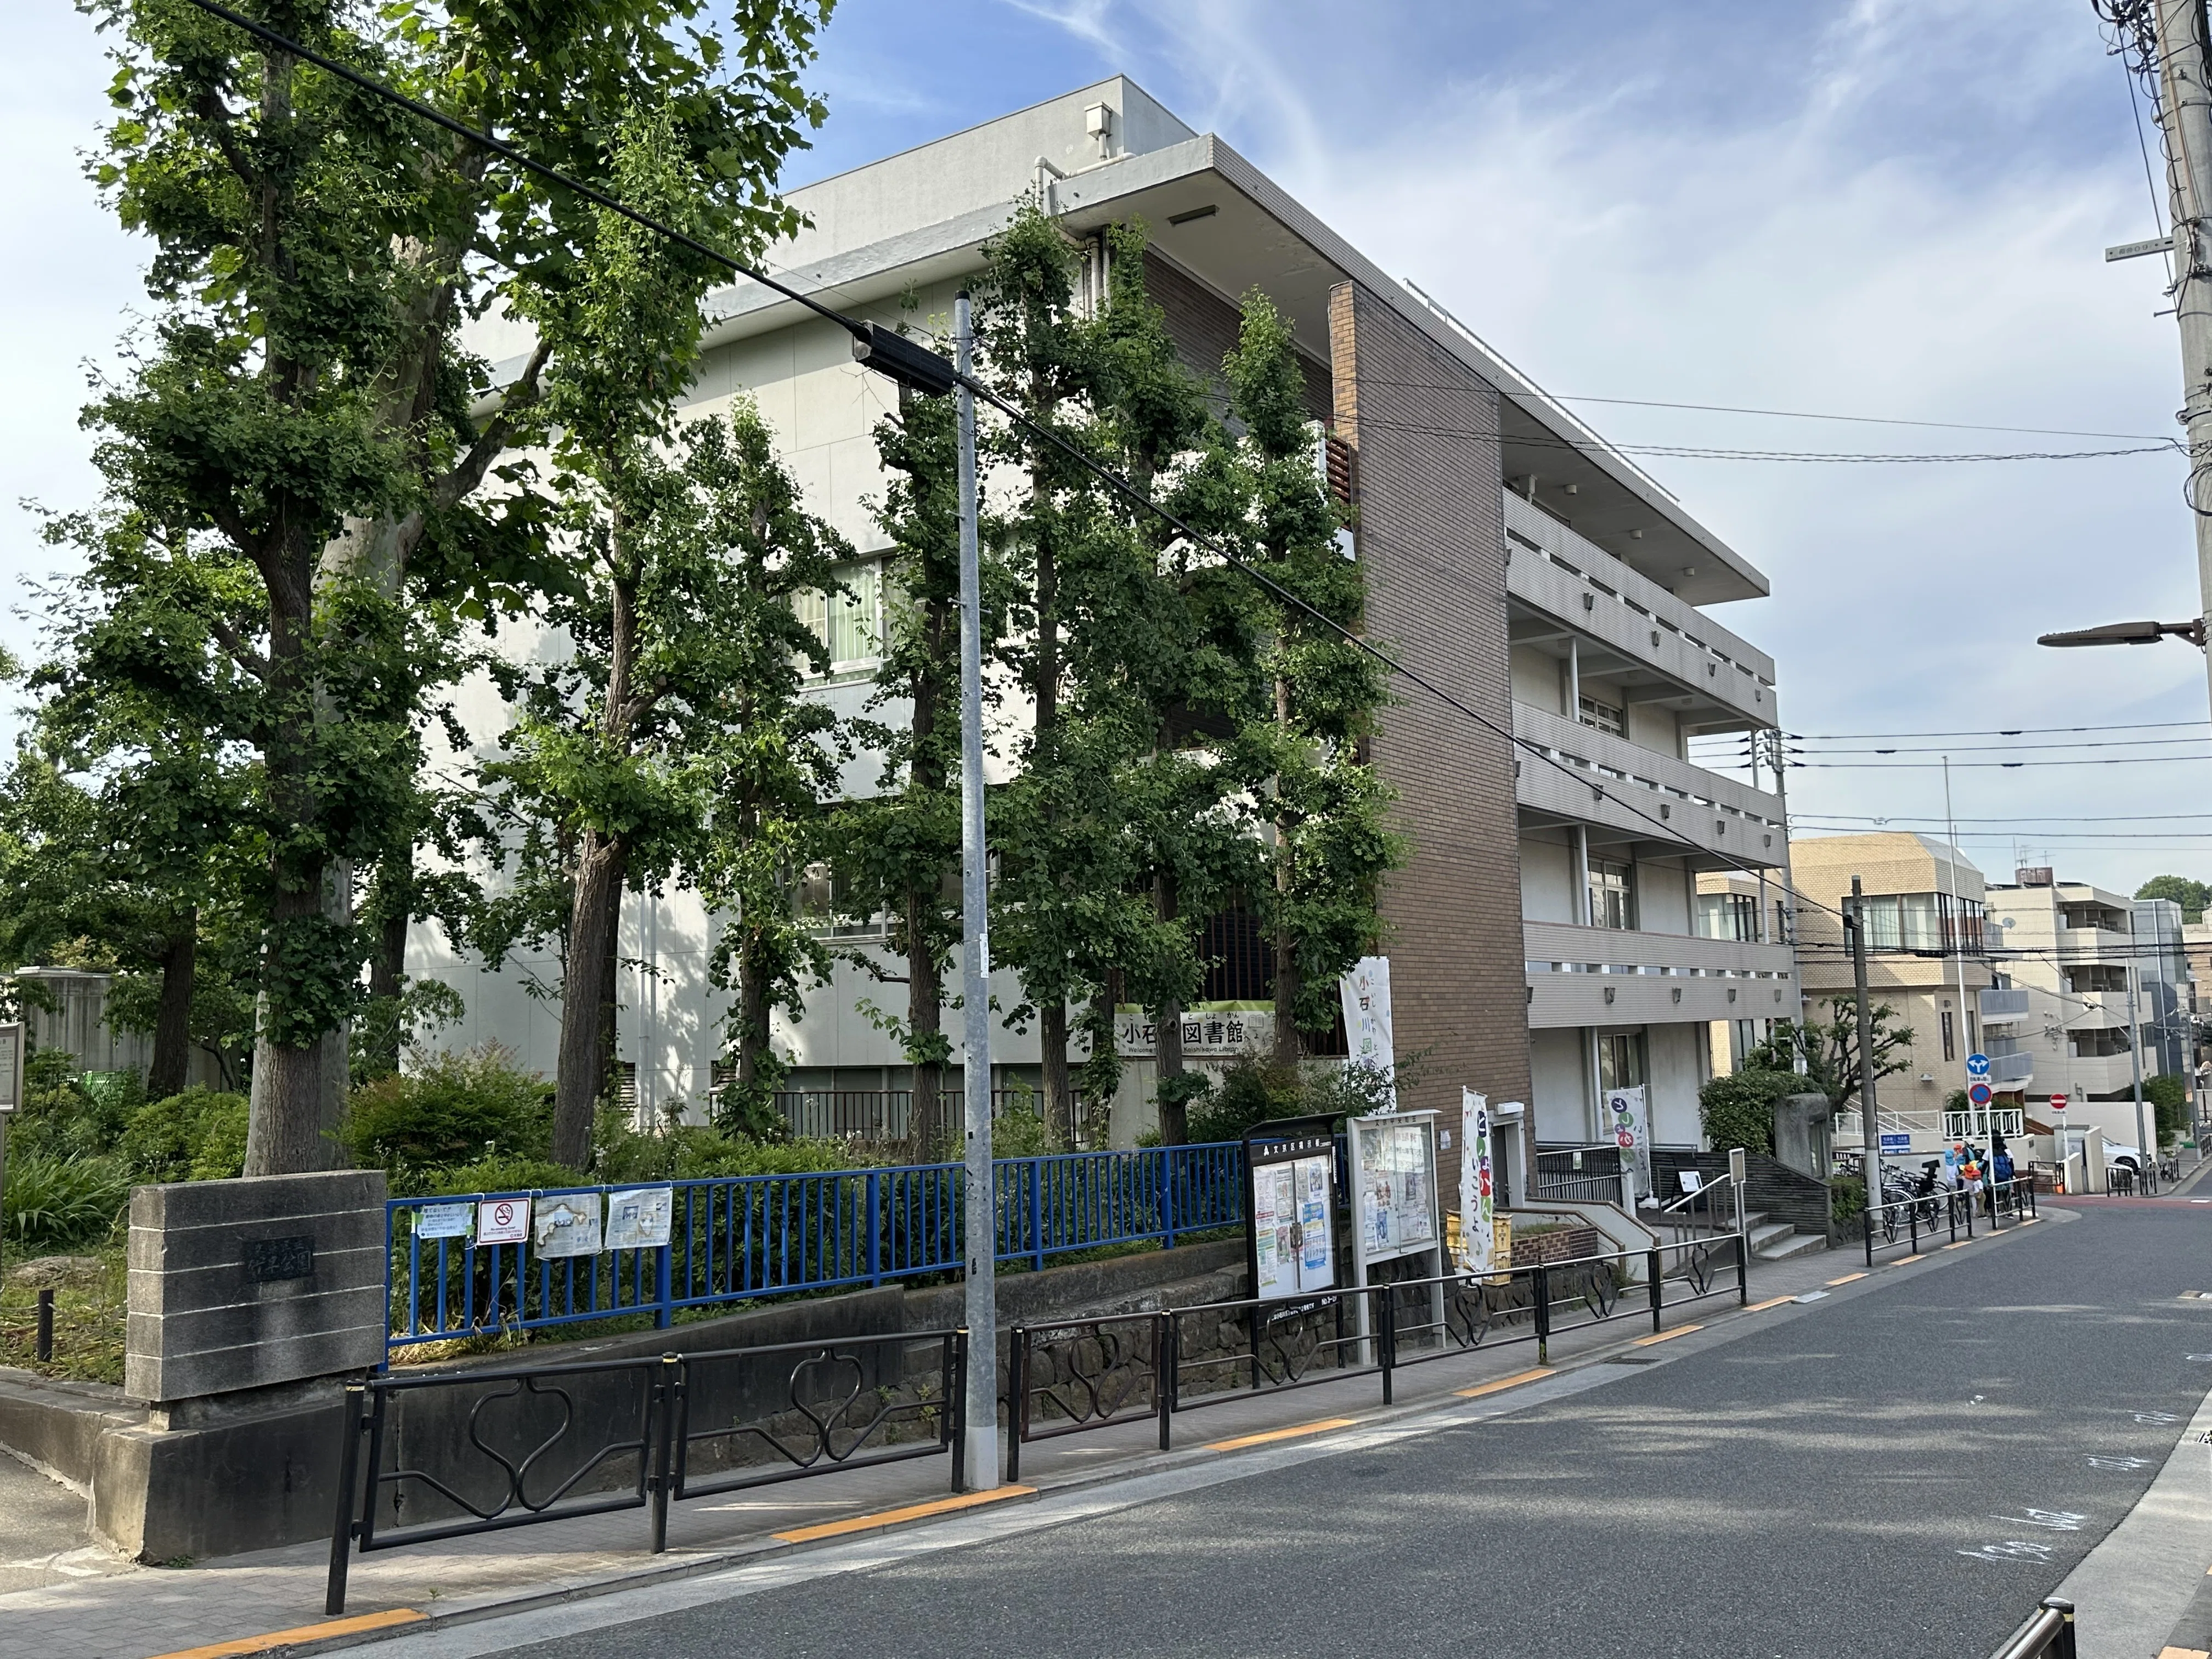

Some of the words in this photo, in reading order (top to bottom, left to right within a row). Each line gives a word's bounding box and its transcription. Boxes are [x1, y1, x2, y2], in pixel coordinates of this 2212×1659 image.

[1124, 1021, 1244, 1044] 小石図書館
